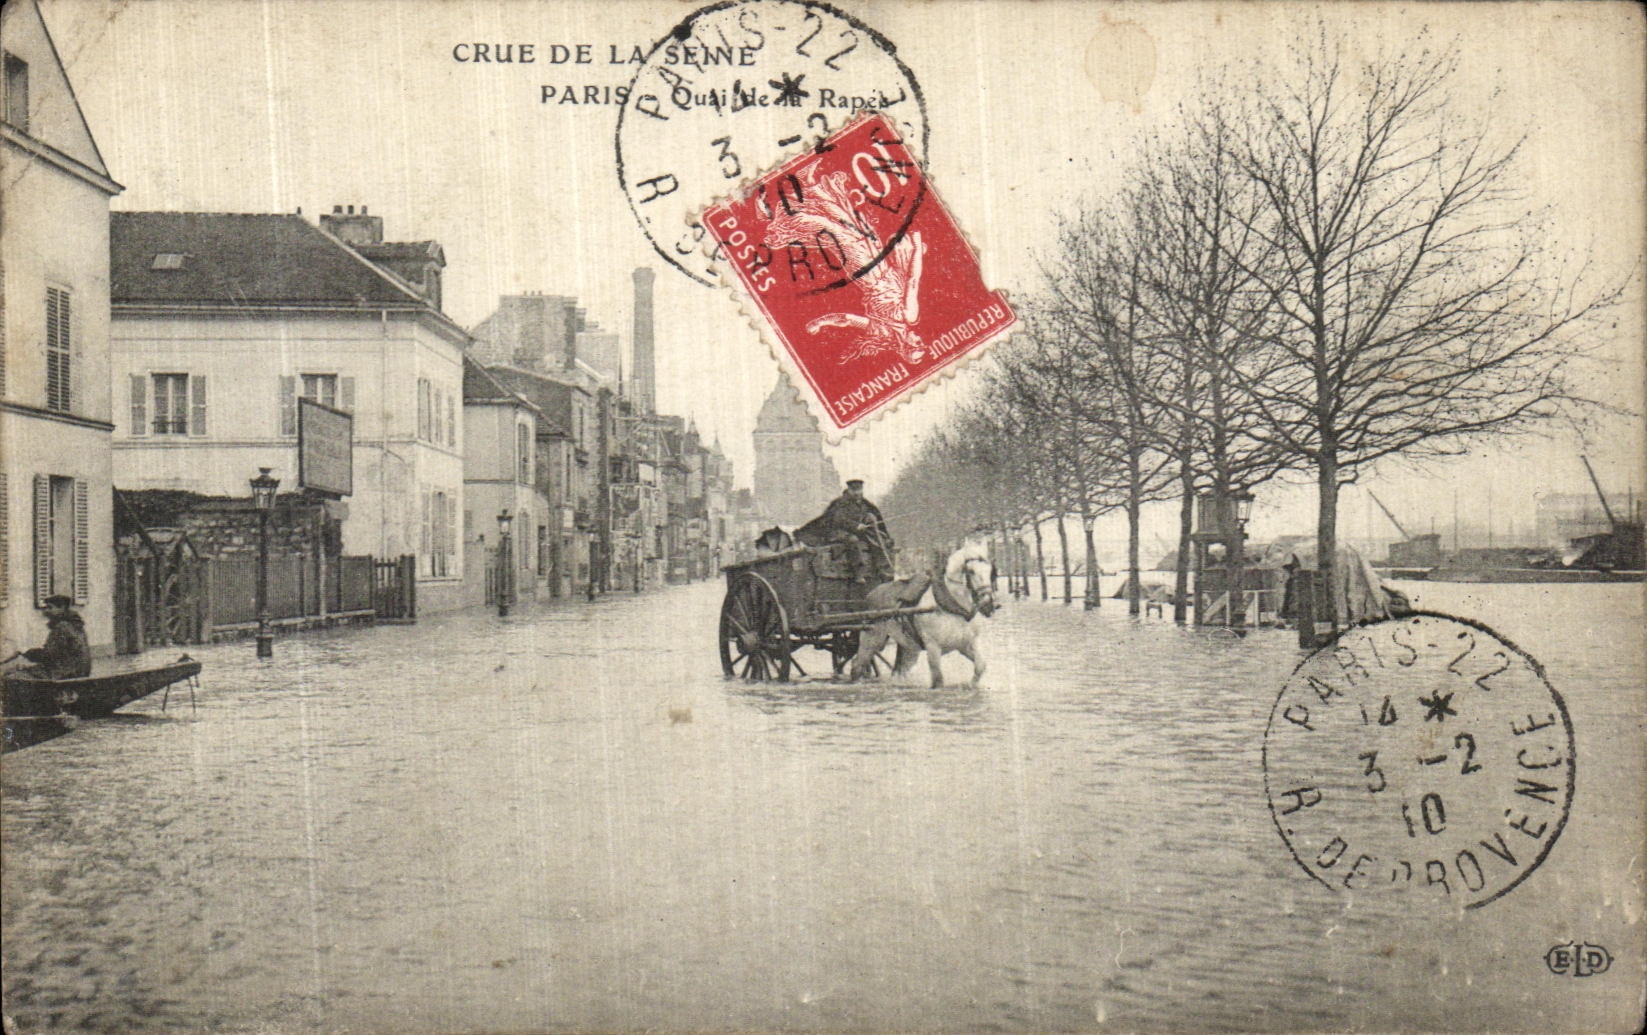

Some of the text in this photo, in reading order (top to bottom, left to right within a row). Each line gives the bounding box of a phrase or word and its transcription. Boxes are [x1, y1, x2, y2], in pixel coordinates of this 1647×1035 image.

[719, 217, 776, 292] POSTES
[1359, 751, 1387, 793] 3
[1402, 793, 1446, 838] 10
